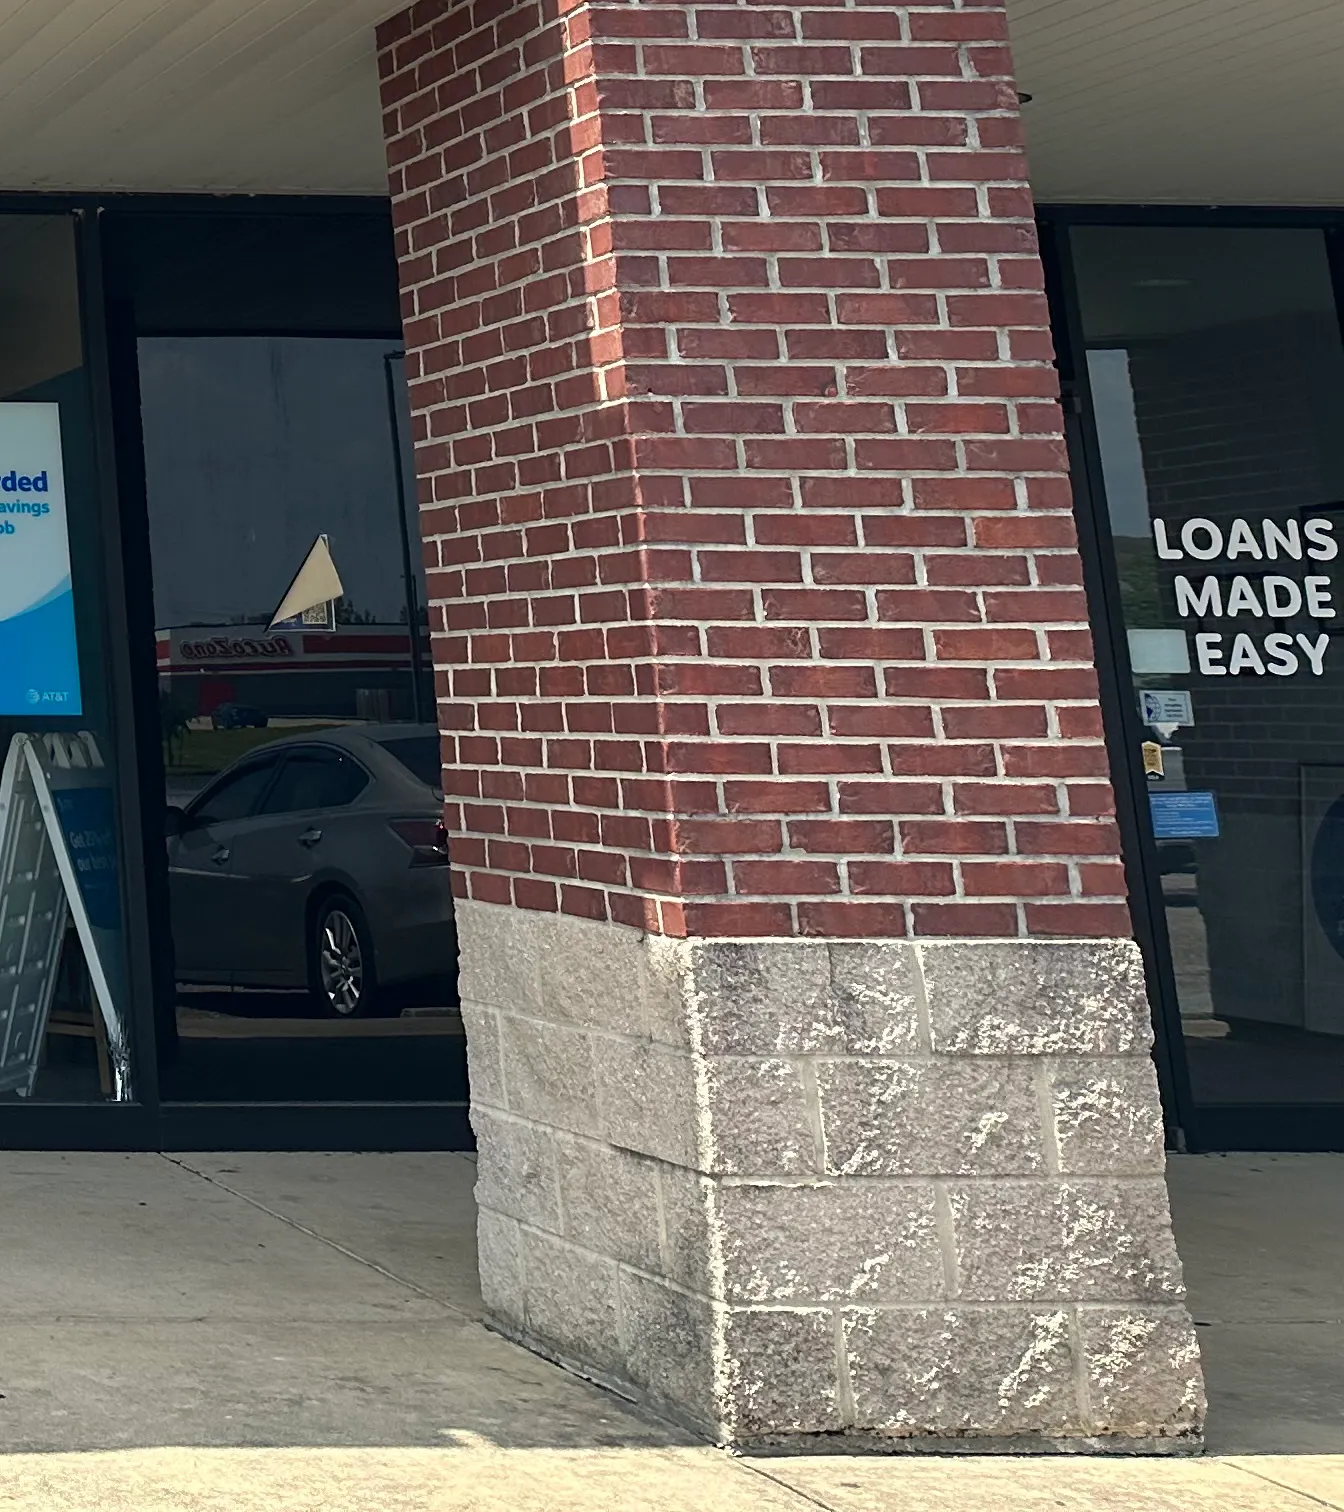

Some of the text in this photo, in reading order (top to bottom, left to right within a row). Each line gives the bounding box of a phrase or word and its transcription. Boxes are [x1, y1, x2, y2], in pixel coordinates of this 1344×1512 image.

[1153, 517, 1339, 561] LOANS
[1174, 575, 1337, 618] MADE
[1195, 633, 1330, 676] EASY
[42, 691, 69, 702] AT&T
